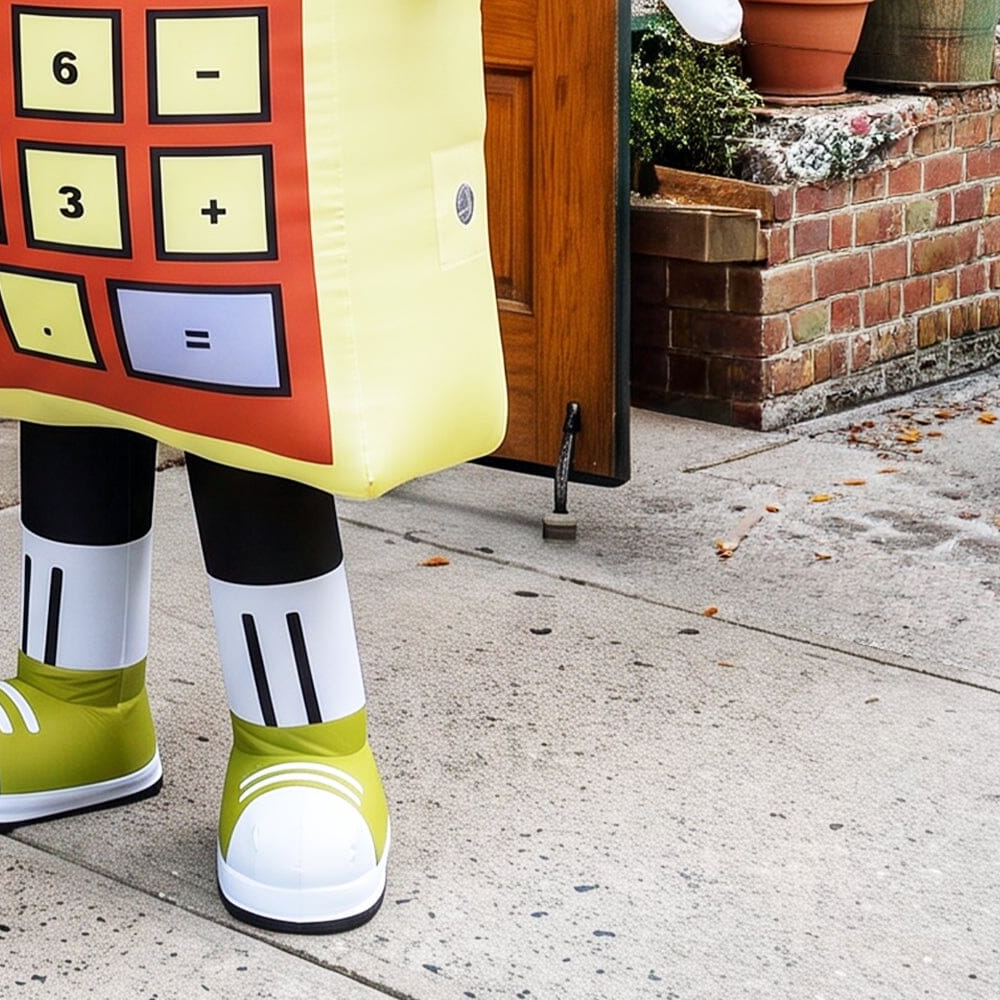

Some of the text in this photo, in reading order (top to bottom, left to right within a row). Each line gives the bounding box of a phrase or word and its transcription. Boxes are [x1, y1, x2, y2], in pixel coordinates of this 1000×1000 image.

[52, 50, 79, 85] 6
[58, 185, 85, 219] 3
[200, 199, 227, 225] +
[184, 329, 211, 350] =
